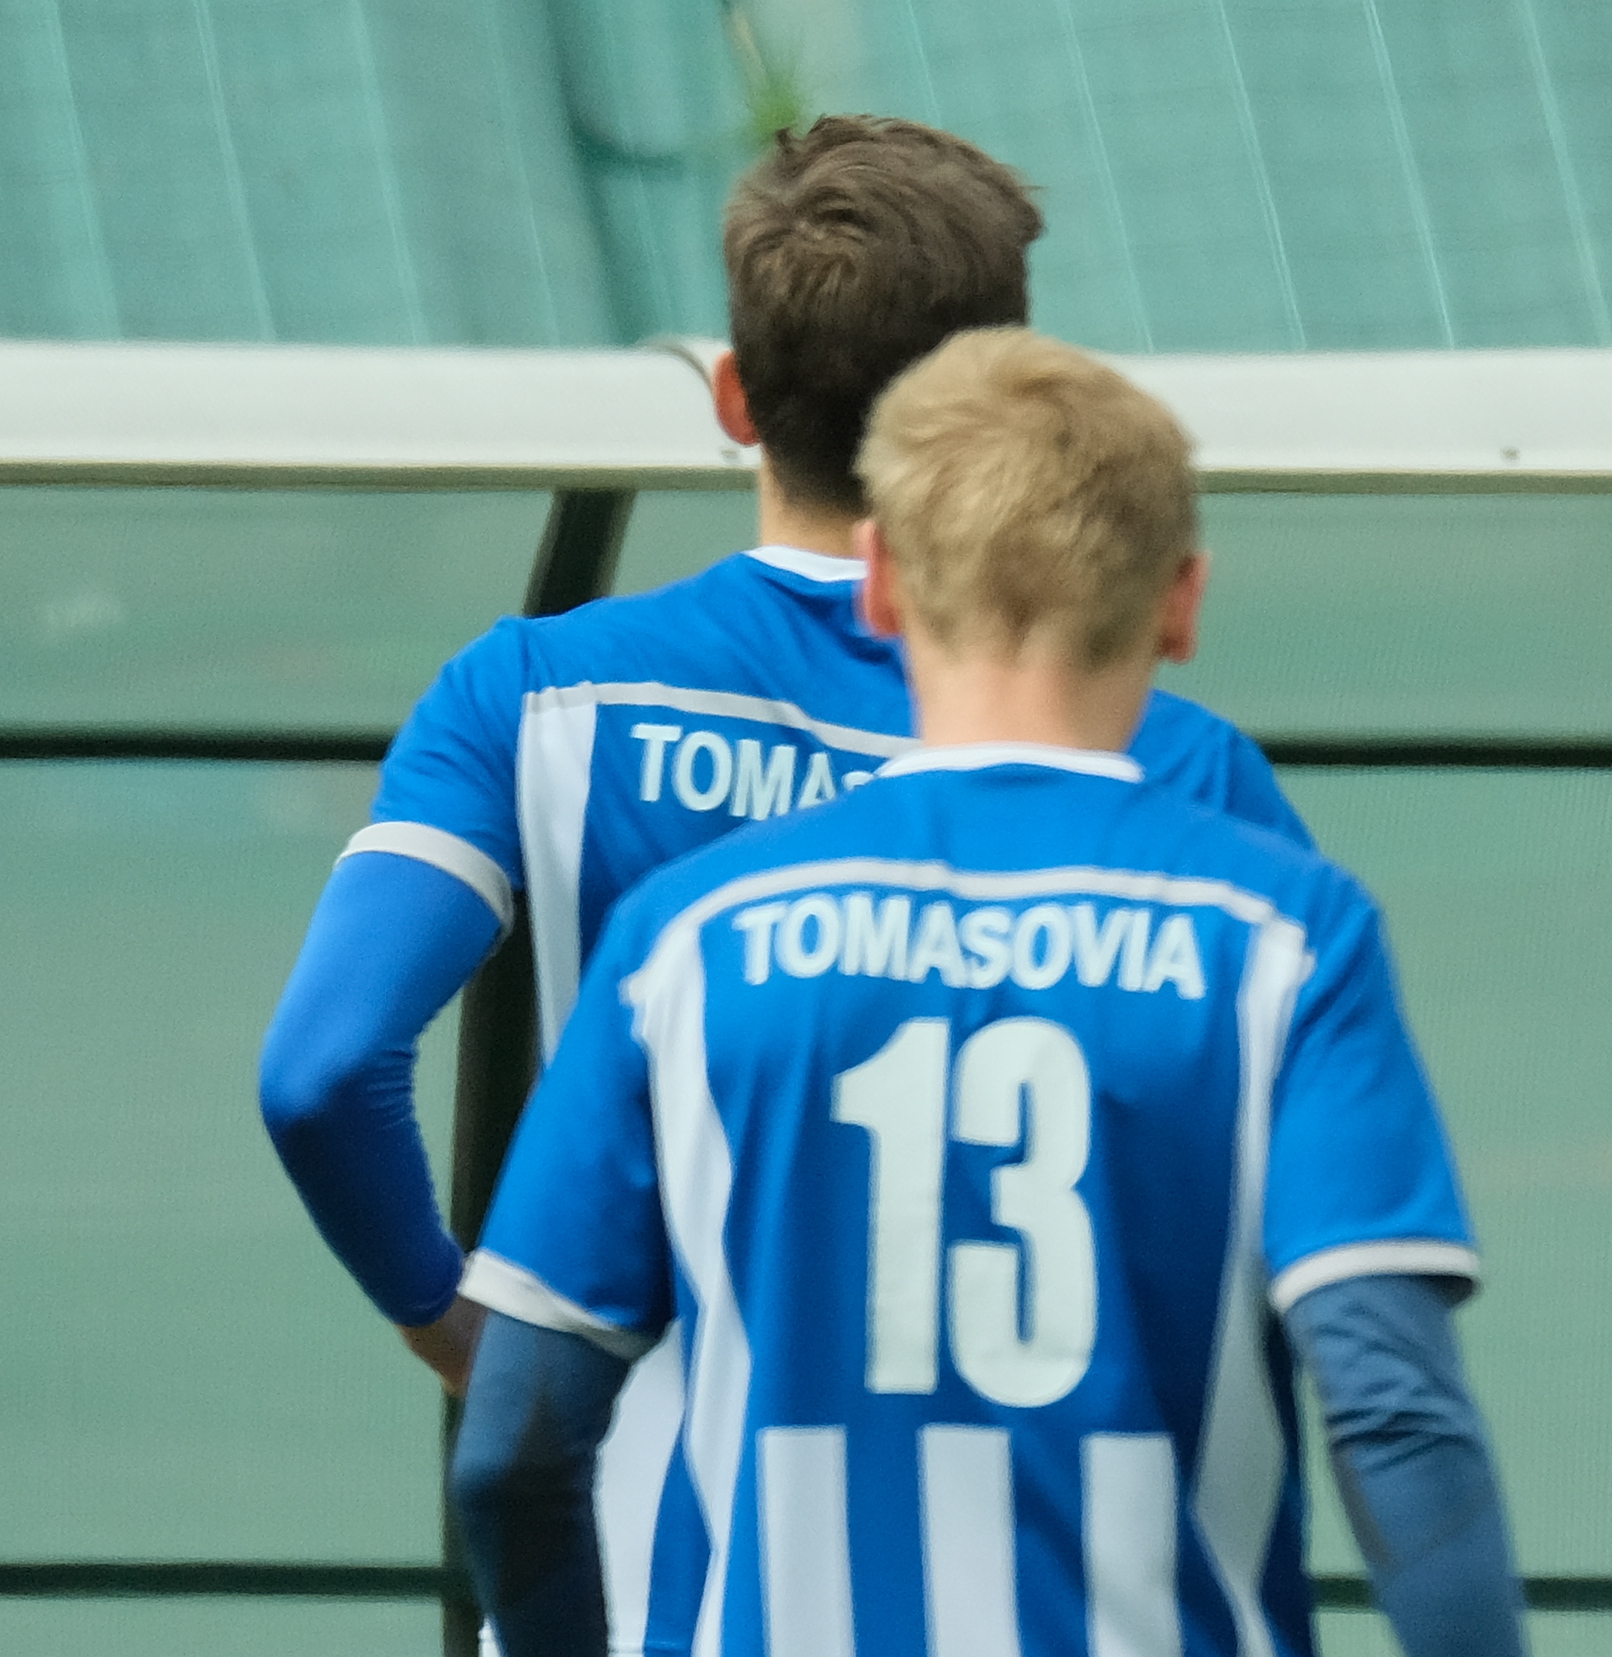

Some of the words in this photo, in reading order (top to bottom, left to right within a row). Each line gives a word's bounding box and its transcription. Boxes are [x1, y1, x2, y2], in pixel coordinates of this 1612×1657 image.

[630, 722, 876, 821] TOMA
[732, 892, 1205, 1000] TOMASOVIA
[833, 1014, 1098, 1409] 13
